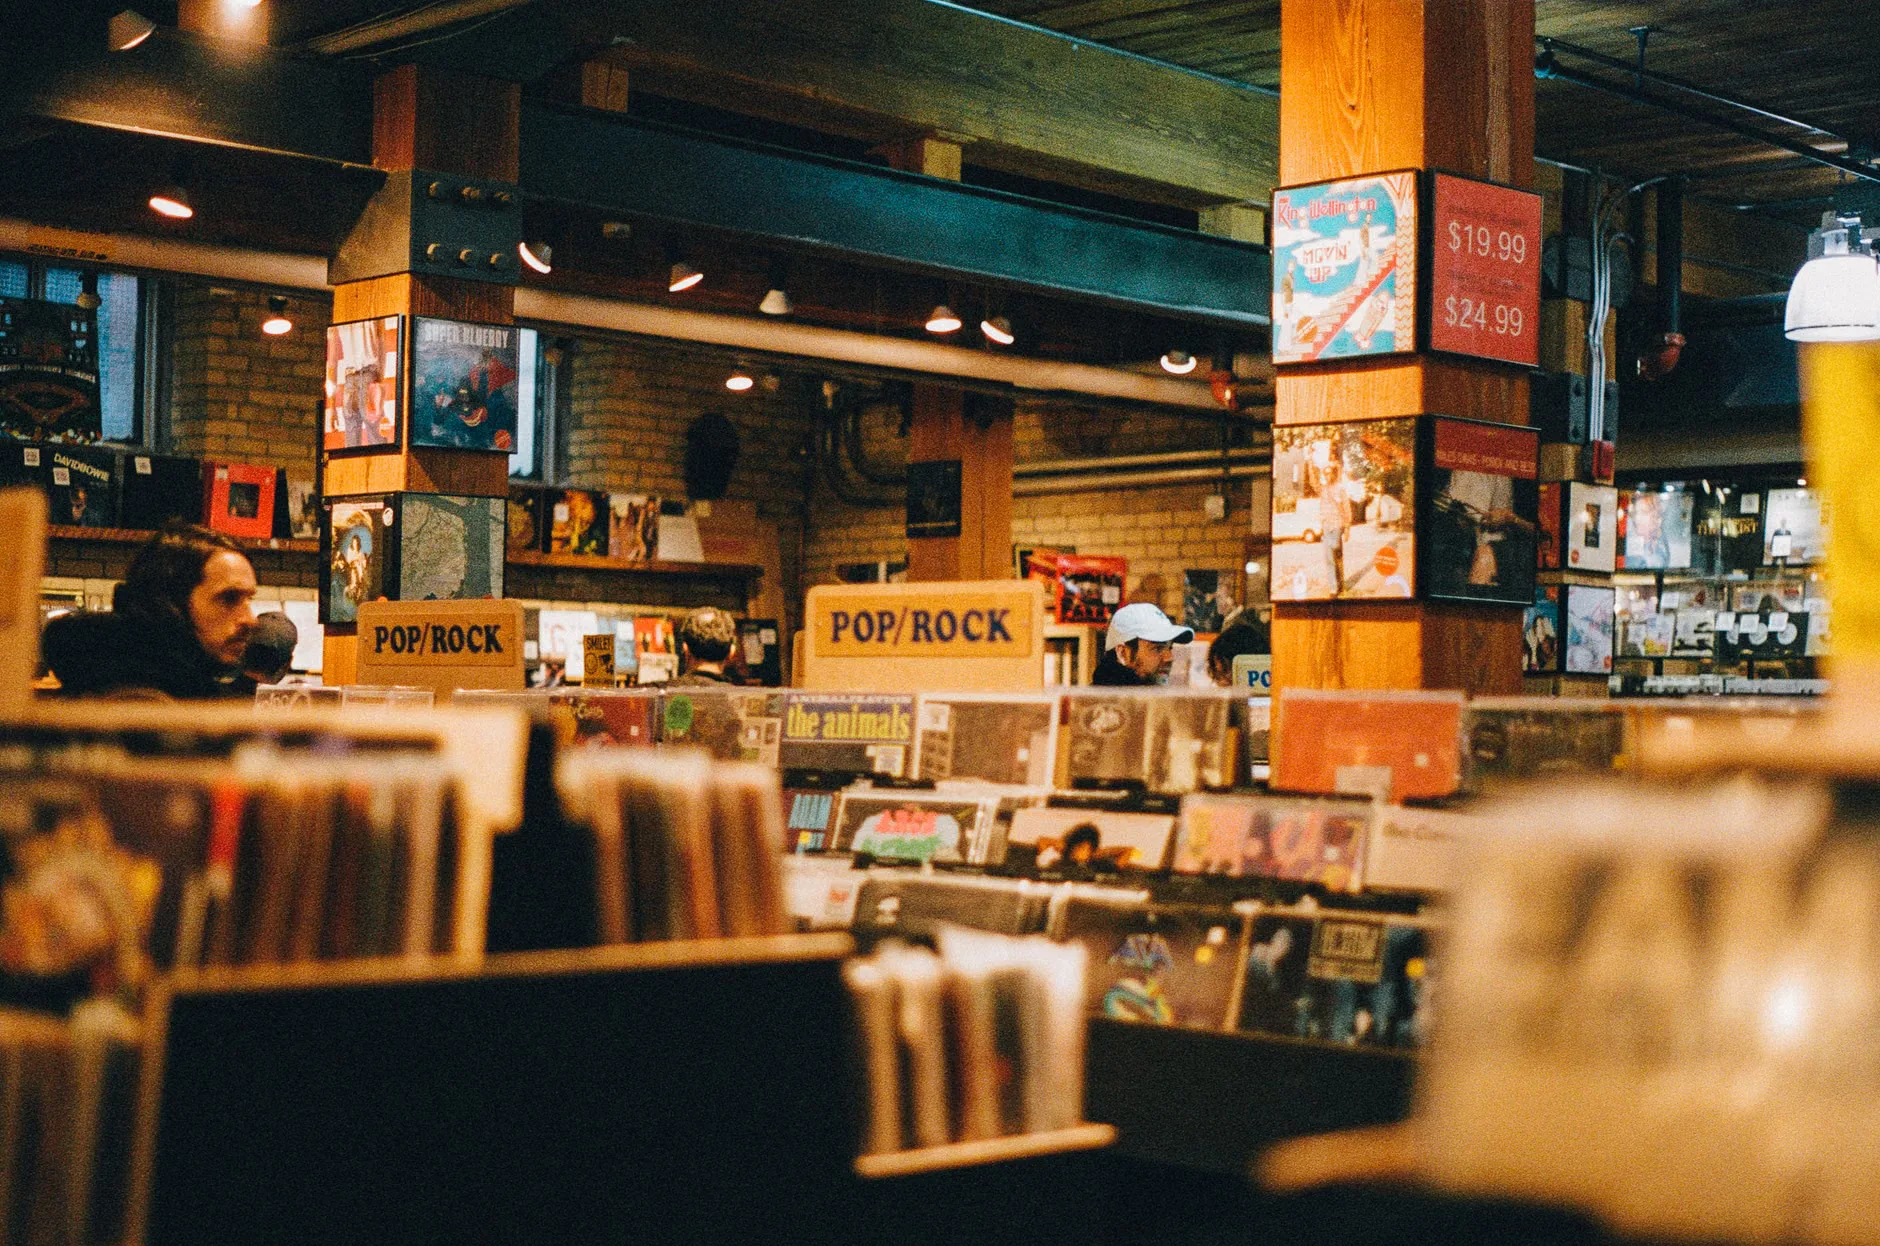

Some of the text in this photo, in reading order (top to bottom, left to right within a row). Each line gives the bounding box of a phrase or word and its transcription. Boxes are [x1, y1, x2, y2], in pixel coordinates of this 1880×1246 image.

[1448, 220, 1526, 264] $19.99
[1309, 265, 1332, 283] UP
[1444, 296, 1523, 337] $24.99
[374, 621, 504, 656] POP/ROCK
[831, 606, 1013, 647] POP/ROCK
[786, 702, 911, 740] the animals
